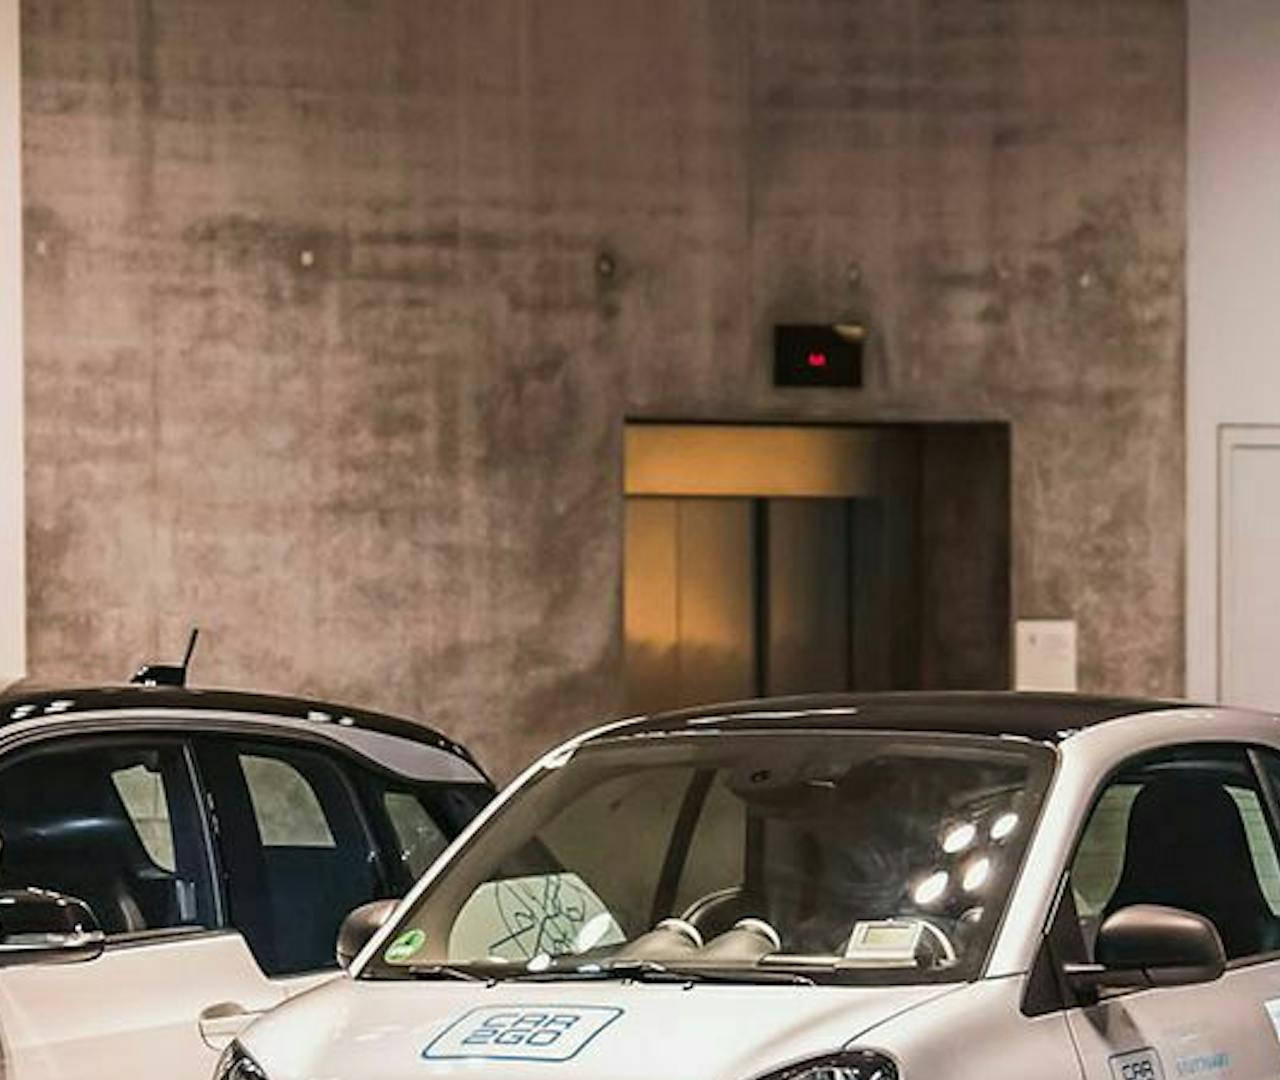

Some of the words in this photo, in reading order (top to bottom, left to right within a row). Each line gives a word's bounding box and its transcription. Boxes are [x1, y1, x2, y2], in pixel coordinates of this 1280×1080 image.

[483, 1013, 580, 1029] CAR
[462, 1028, 562, 1046] 2GO
[1122, 1061, 1154, 1080] CAR
